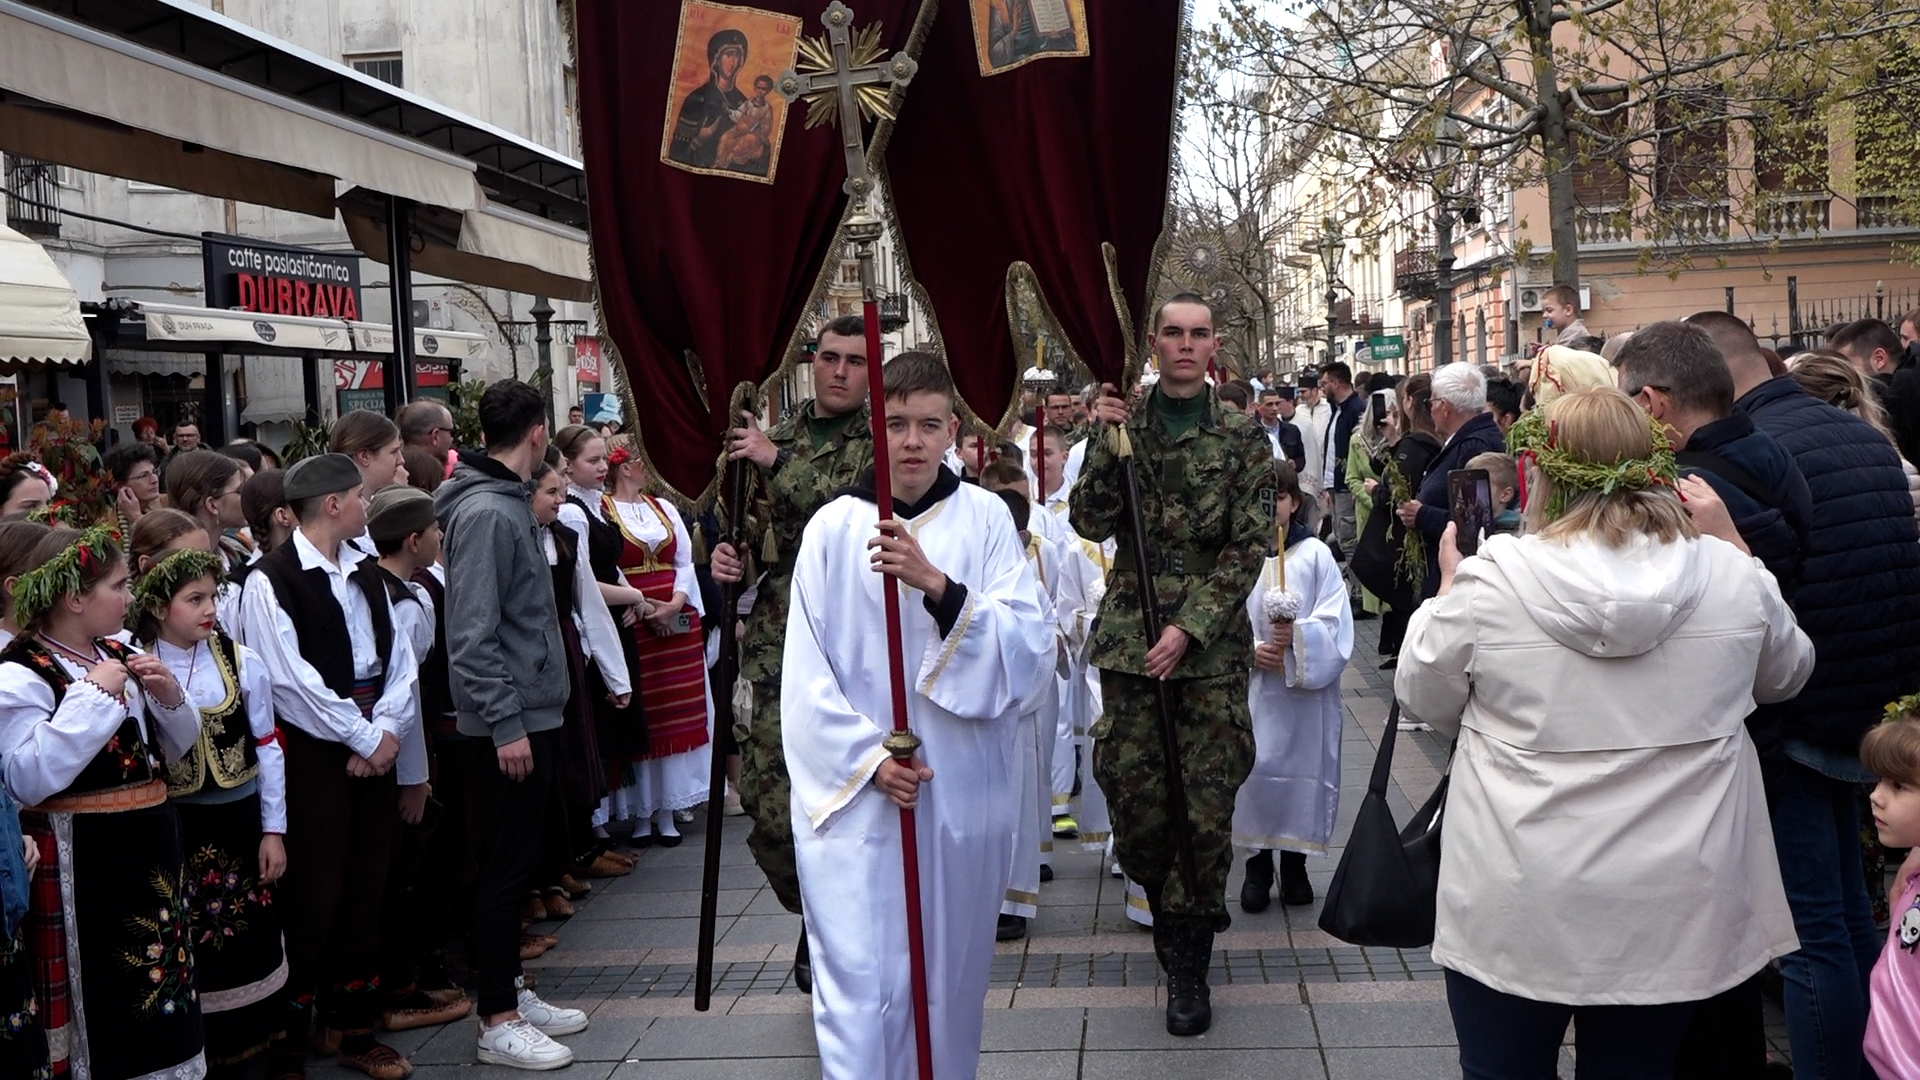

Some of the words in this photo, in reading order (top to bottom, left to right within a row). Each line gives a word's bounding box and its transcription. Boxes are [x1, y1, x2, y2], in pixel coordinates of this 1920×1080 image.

[265, 252, 349, 282] poslastičarnica
[238, 272, 359, 320] DUBRAVA
[1374, 344, 1400, 353] RUSKA
